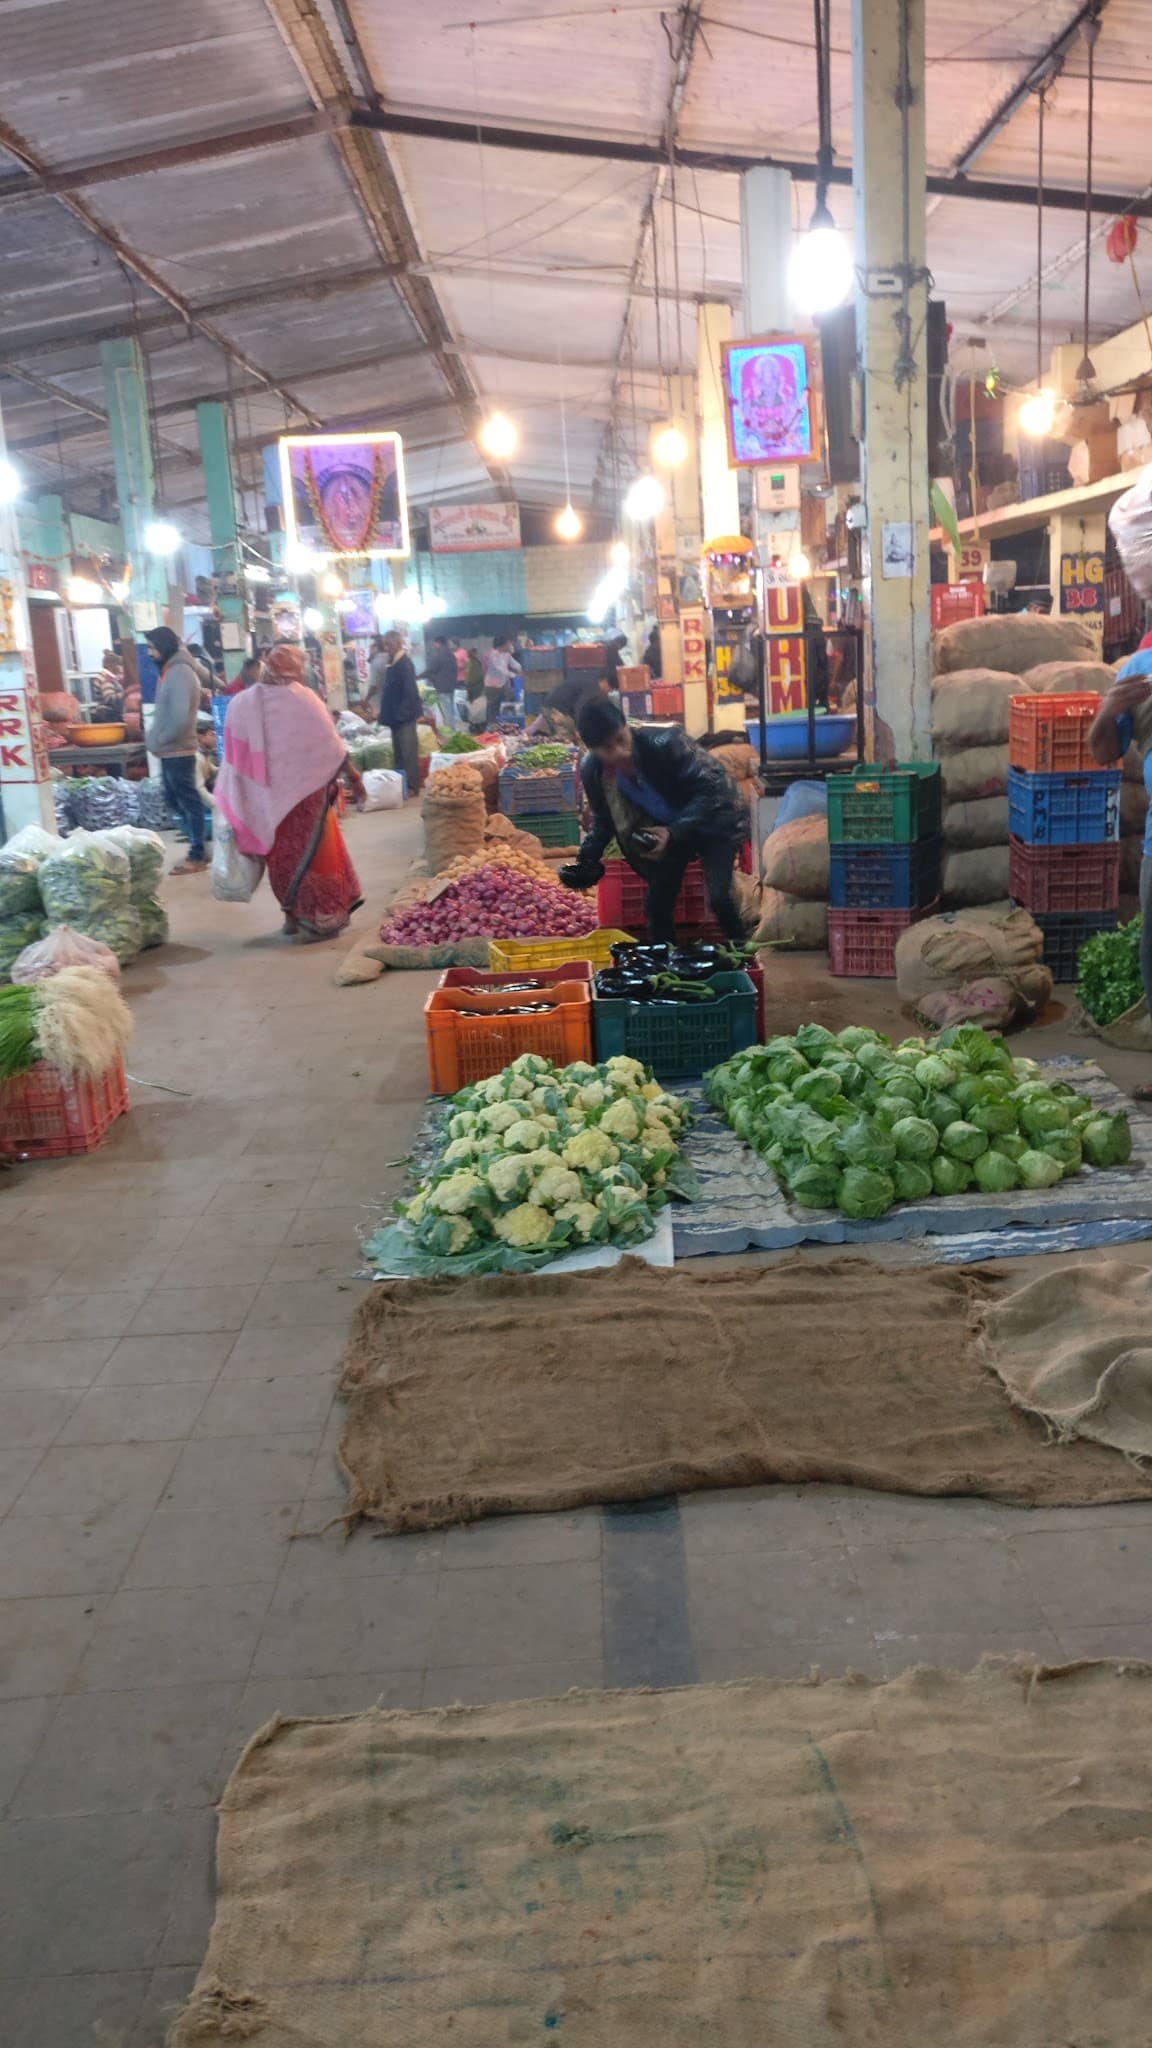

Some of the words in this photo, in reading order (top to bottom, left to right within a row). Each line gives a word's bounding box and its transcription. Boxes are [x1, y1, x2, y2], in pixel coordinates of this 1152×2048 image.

[961, 550, 982, 567] 39
[1062, 557, 1104, 586] HG
[683, 618, 704, 676] RDK
[716, 646, 732, 672] H
[0, 694, 29, 767] RRK
